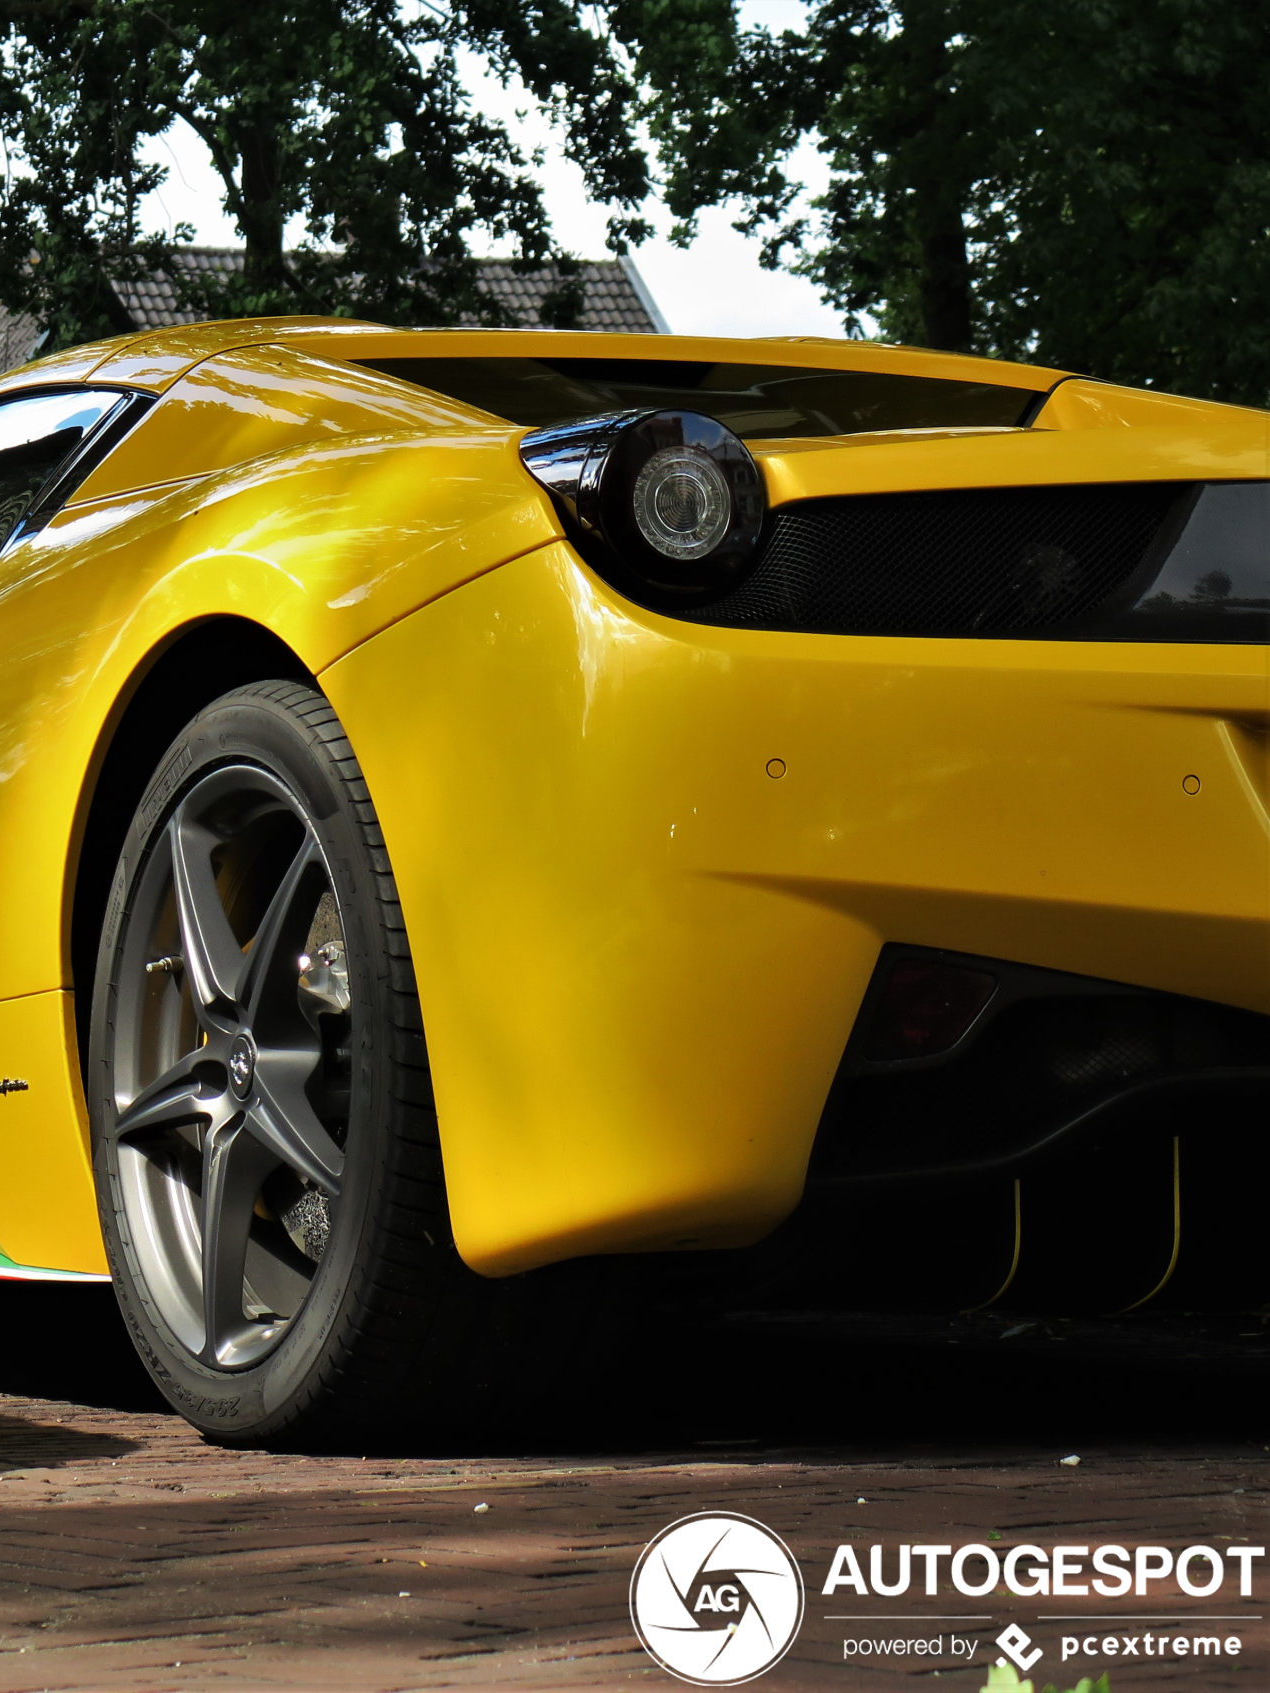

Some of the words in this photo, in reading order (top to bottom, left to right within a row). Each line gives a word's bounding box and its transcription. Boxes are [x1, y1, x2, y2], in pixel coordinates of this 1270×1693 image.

[135, 738, 193, 840] PIRELLI
[127, 1311, 172, 1385] ZR20
[172, 1381, 241, 1418] 295/35
